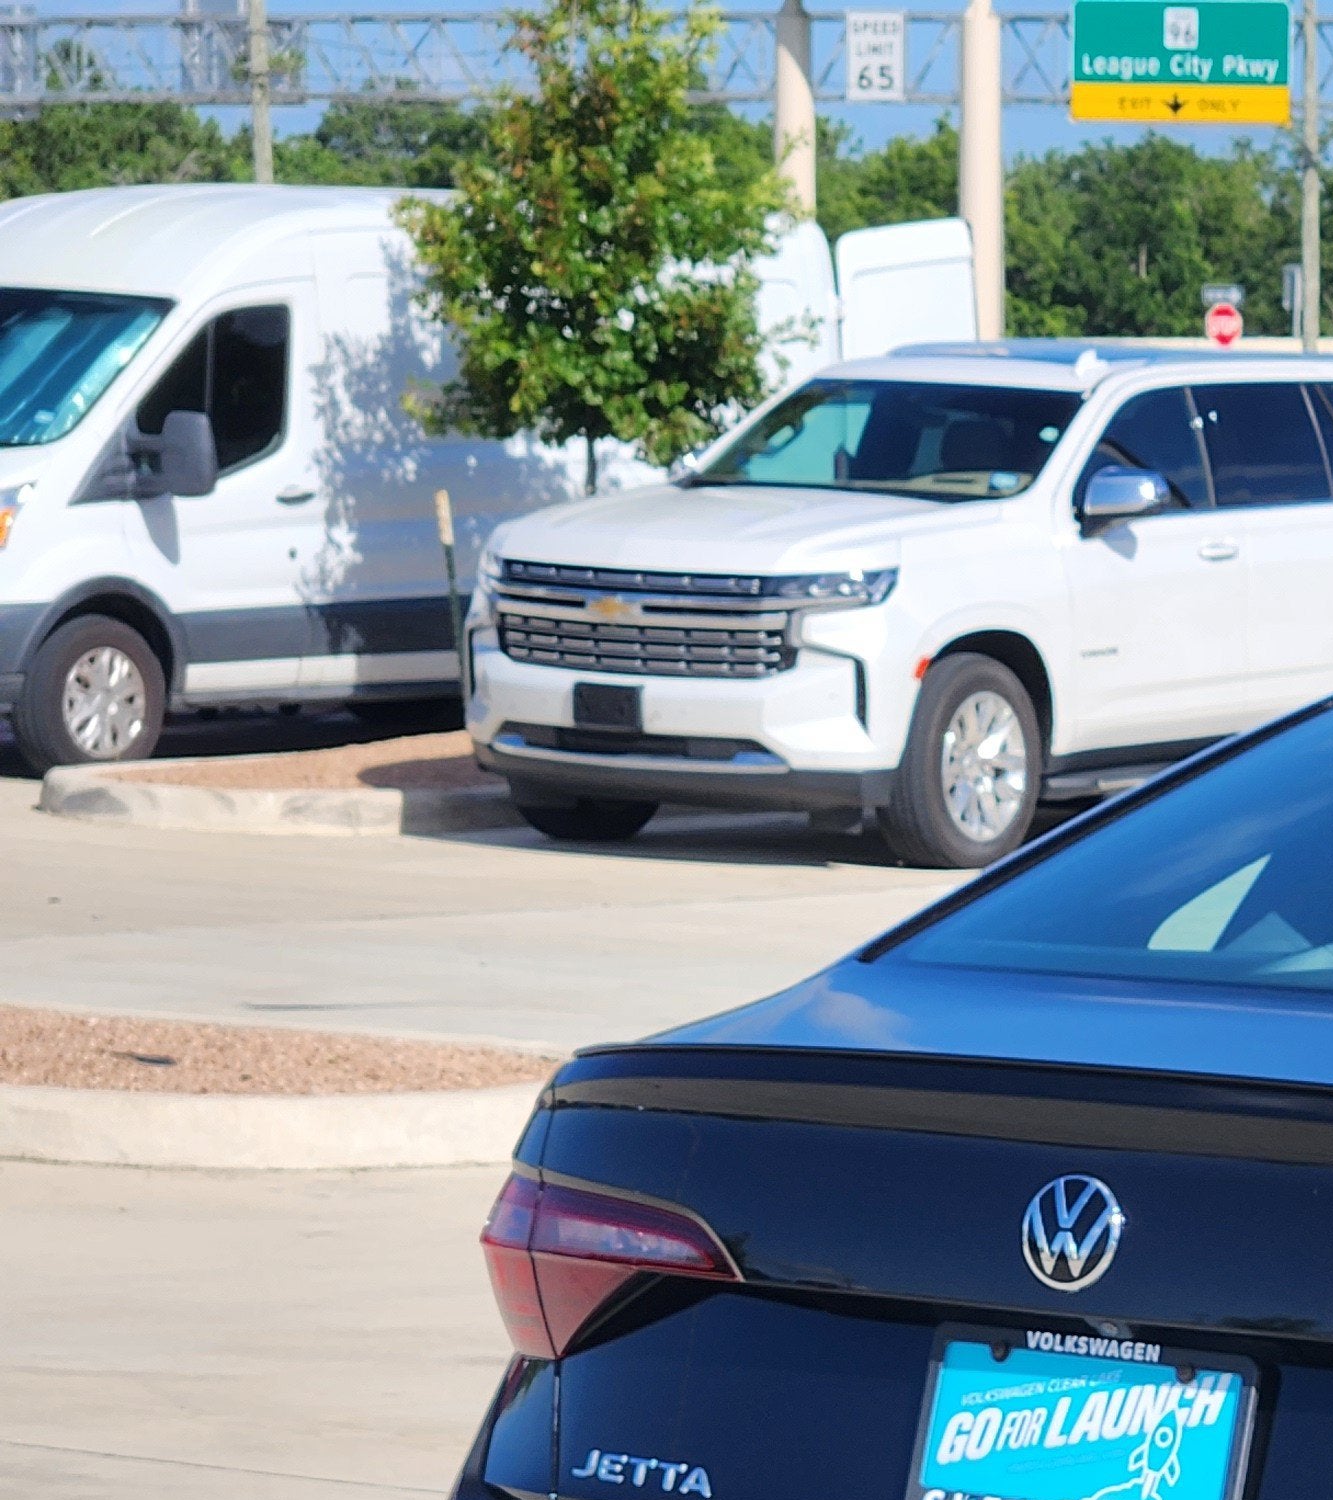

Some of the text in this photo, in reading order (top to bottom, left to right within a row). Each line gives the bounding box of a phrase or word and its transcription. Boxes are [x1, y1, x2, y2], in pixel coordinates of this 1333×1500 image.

[852, 21, 899, 34] SPEED
[854, 42, 894, 56] LIMIT
[857, 65, 894, 90] 65
[1081, 53, 1280, 83] League City Pkwy
[1026, 1330, 1161, 1363] VOLKSWAGEN
[961, 1381, 1046, 1407] VOLKSWAGEN
[1047, 1374, 1090, 1393] CLEAR
[936, 1407, 1003, 1465] GO
[995, 1406, 1049, 1451] FOR
[1043, 1372, 1233, 1449] LAUNCH
[571, 1449, 712, 1499] JETTA
